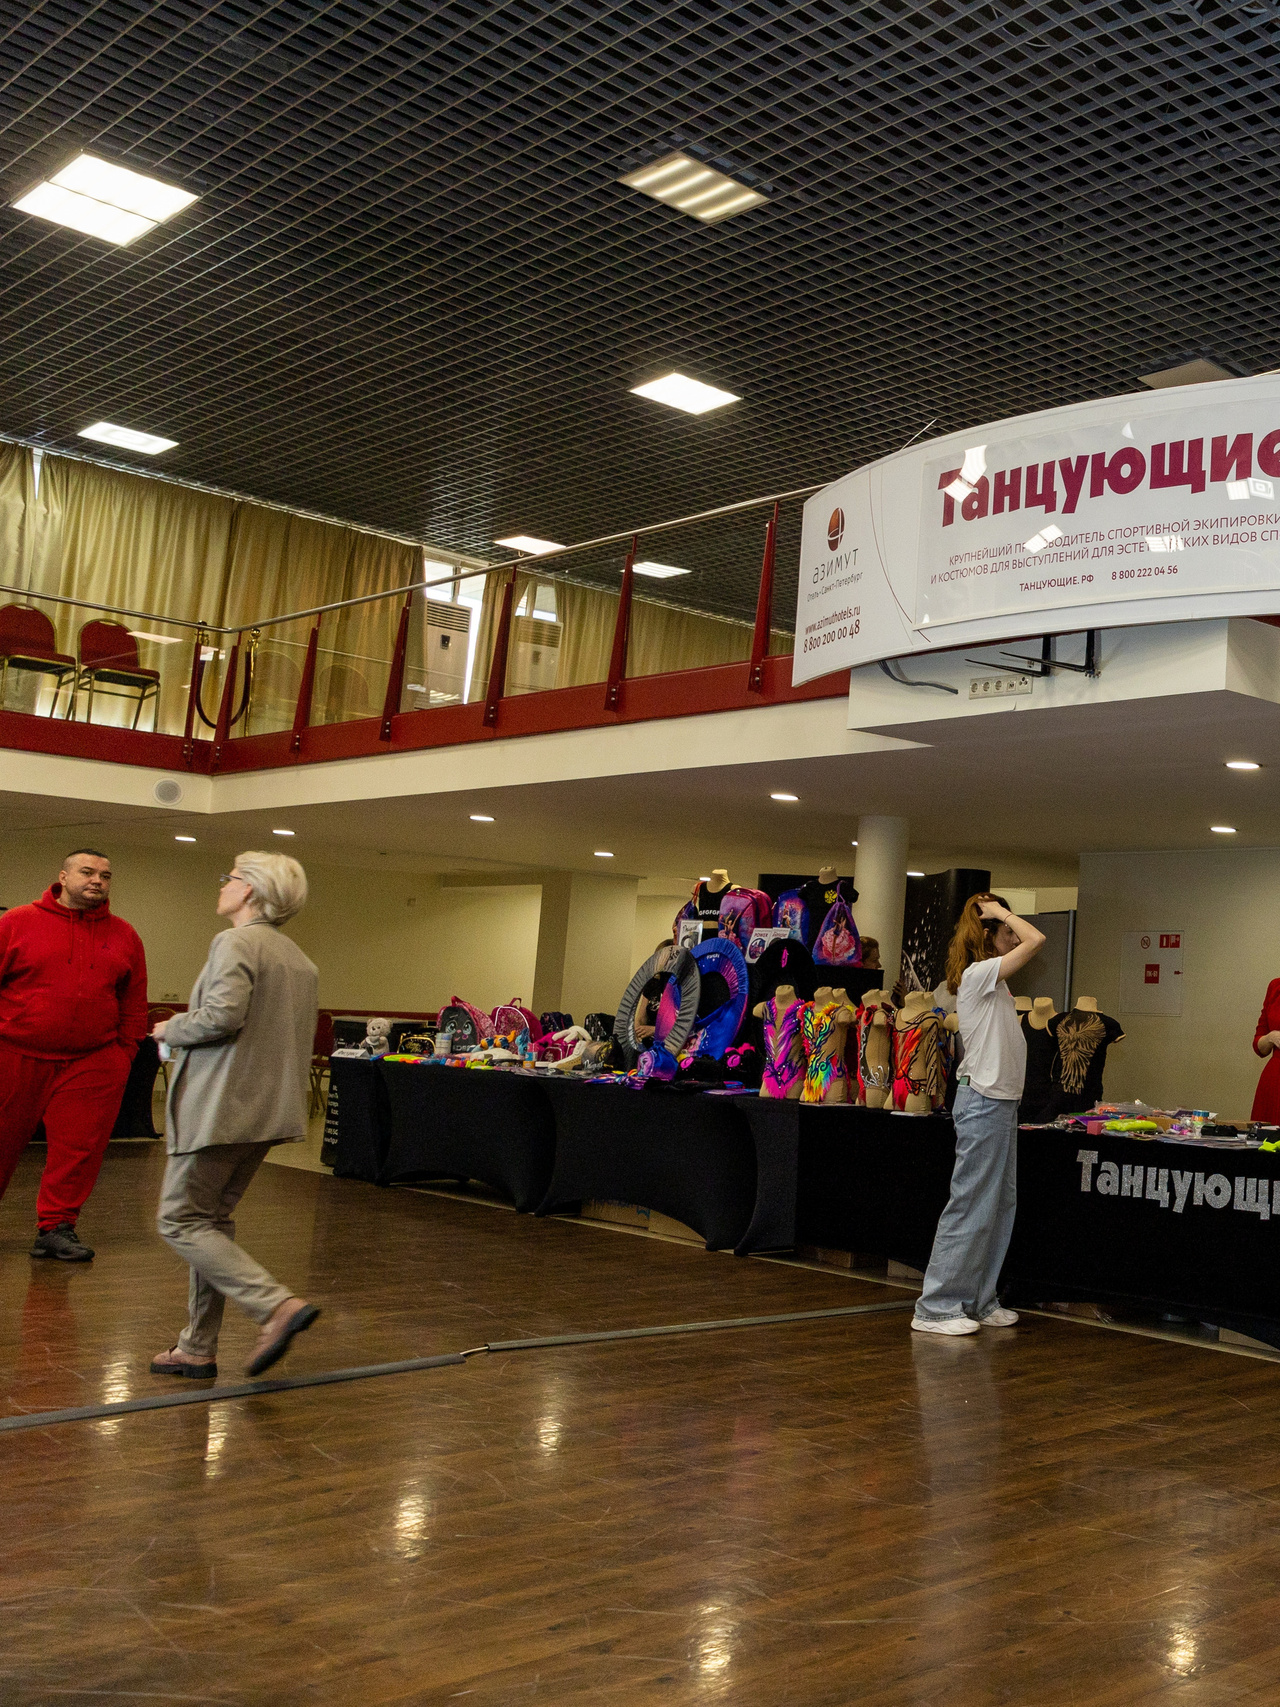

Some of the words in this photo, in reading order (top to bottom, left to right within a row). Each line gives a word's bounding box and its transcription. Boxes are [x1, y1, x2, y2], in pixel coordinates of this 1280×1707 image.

[930, 575, 937, 585] И
[938, 564, 989, 583] КОСТЮМОВ
[990, 561, 1010, 574] ДЛЯ
[1012, 545, 1089, 570] ВЫСТУПЛЕНИЙ
[1091, 545, 1114, 560] ДЛЯ
[1212, 531, 1257, 546] ВИДОВ
[950, 543, 1012, 566] КРУПНЕЙШИЙ
[1015, 531, 1105, 554] ПРВОДИТЕЛЬ
[1107, 519, 1190, 540] СПОРТИВНОЙ
[1111, 571, 1117, 581] 8
[1118, 569, 1135, 580] 800
[1137, 567, 1152, 578] 222
[1154, 566, 1165, 576] 04
[1167, 564, 1178, 575] 56
[803, 639, 808, 653] 8
[809, 636, 821, 651] 800
[822, 630, 836, 645] 200
[838, 626, 847, 640] 00
[849, 619, 860, 639] 48
